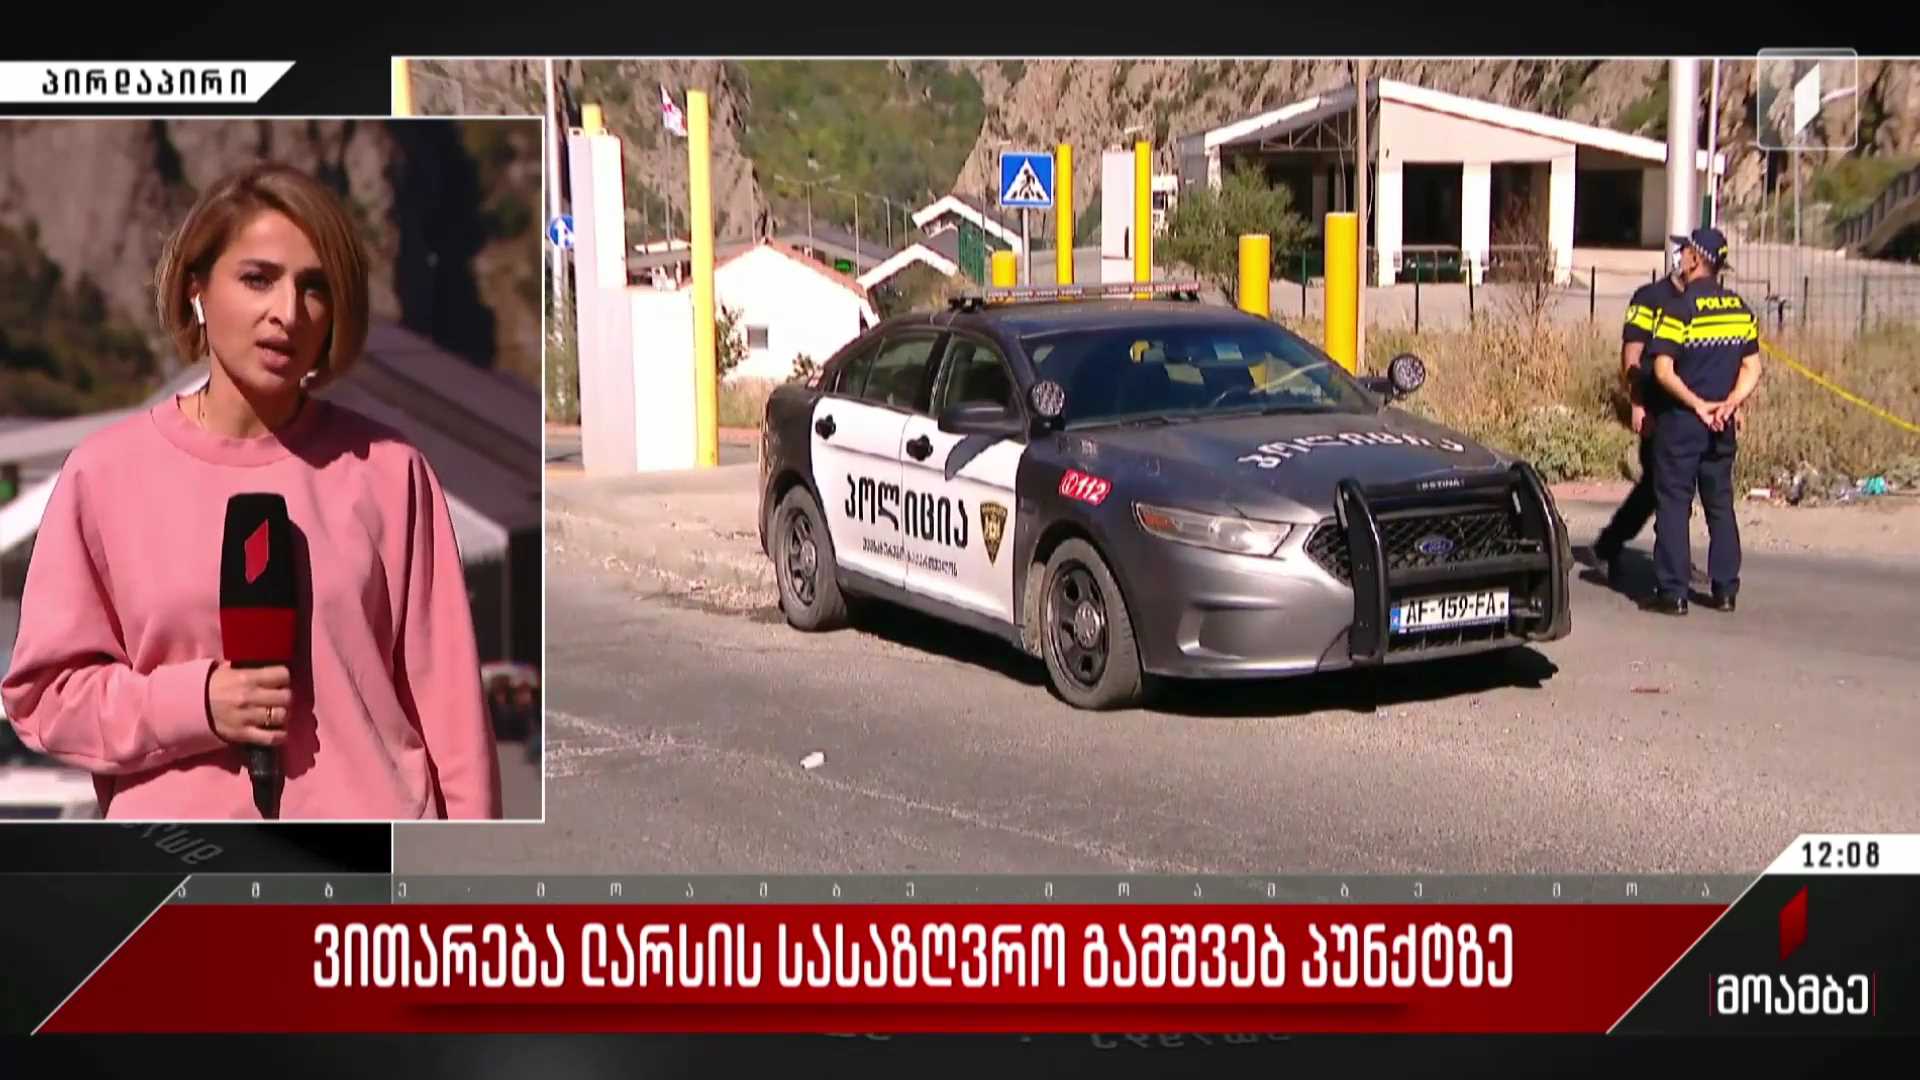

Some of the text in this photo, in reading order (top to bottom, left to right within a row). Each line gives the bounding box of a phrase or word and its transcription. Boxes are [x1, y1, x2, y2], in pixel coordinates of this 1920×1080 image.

[1696, 296, 1742, 311] POLICE
[1075, 474, 1107, 502] 112
[844, 473, 968, 549] პოლიცია
[1405, 590, 1496, 625] AF-159-FA
